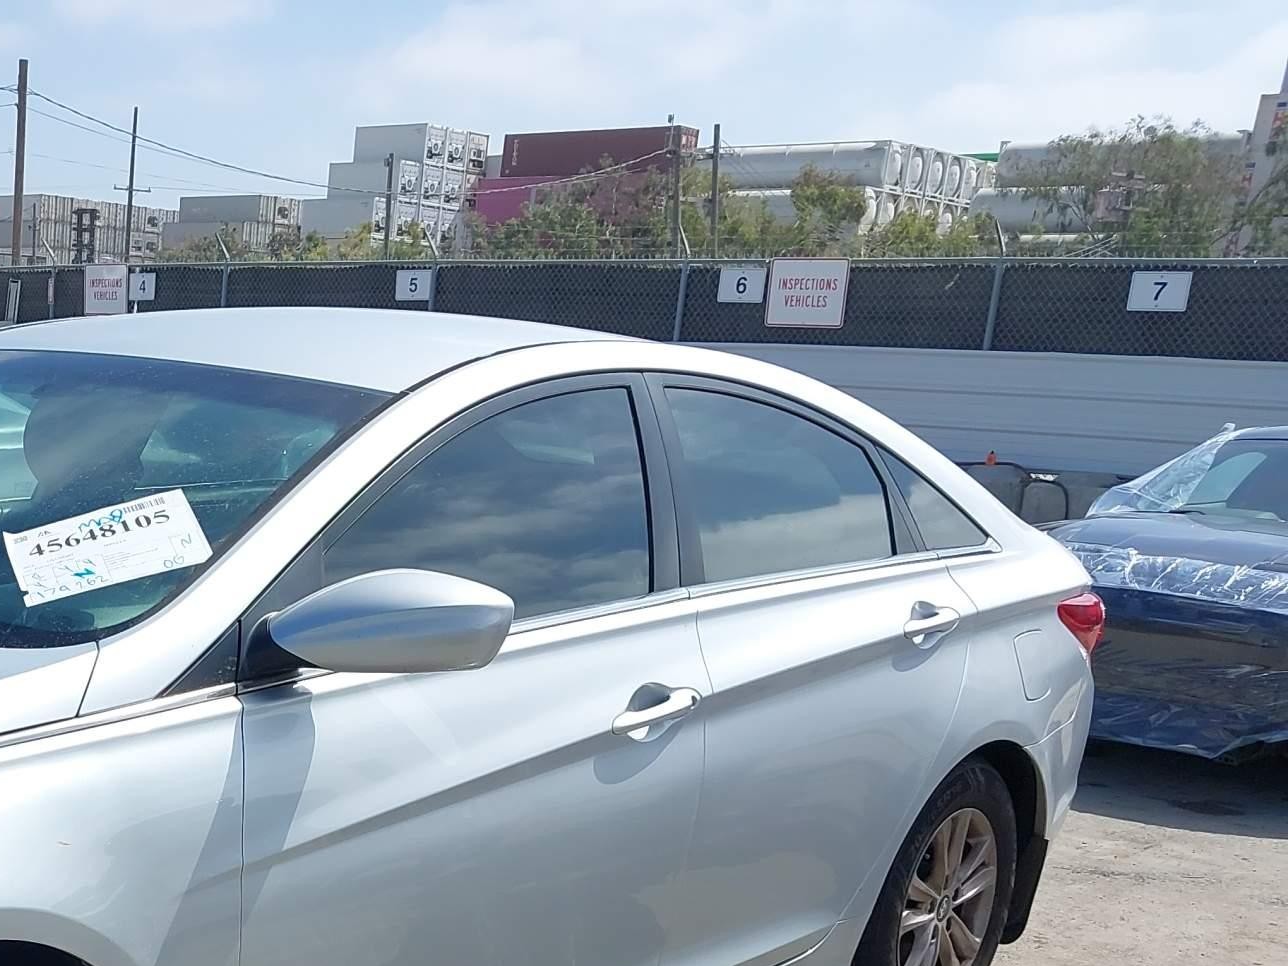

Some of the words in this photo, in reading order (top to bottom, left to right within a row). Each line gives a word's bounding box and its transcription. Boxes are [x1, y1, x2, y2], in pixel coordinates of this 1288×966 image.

[89, 278, 123, 289] INSPECTIONS
[139, 279, 146, 294] 4
[409, 277, 418, 294] 5
[736, 276, 748, 294] 6
[778, 277, 839, 291] INSPECTIONS
[93, 291, 118, 301] VEHICLES
[1153, 282, 1167, 301] 7
[784, 295, 828, 308] VEHICLES
[29, 508, 171, 557] 45648105
